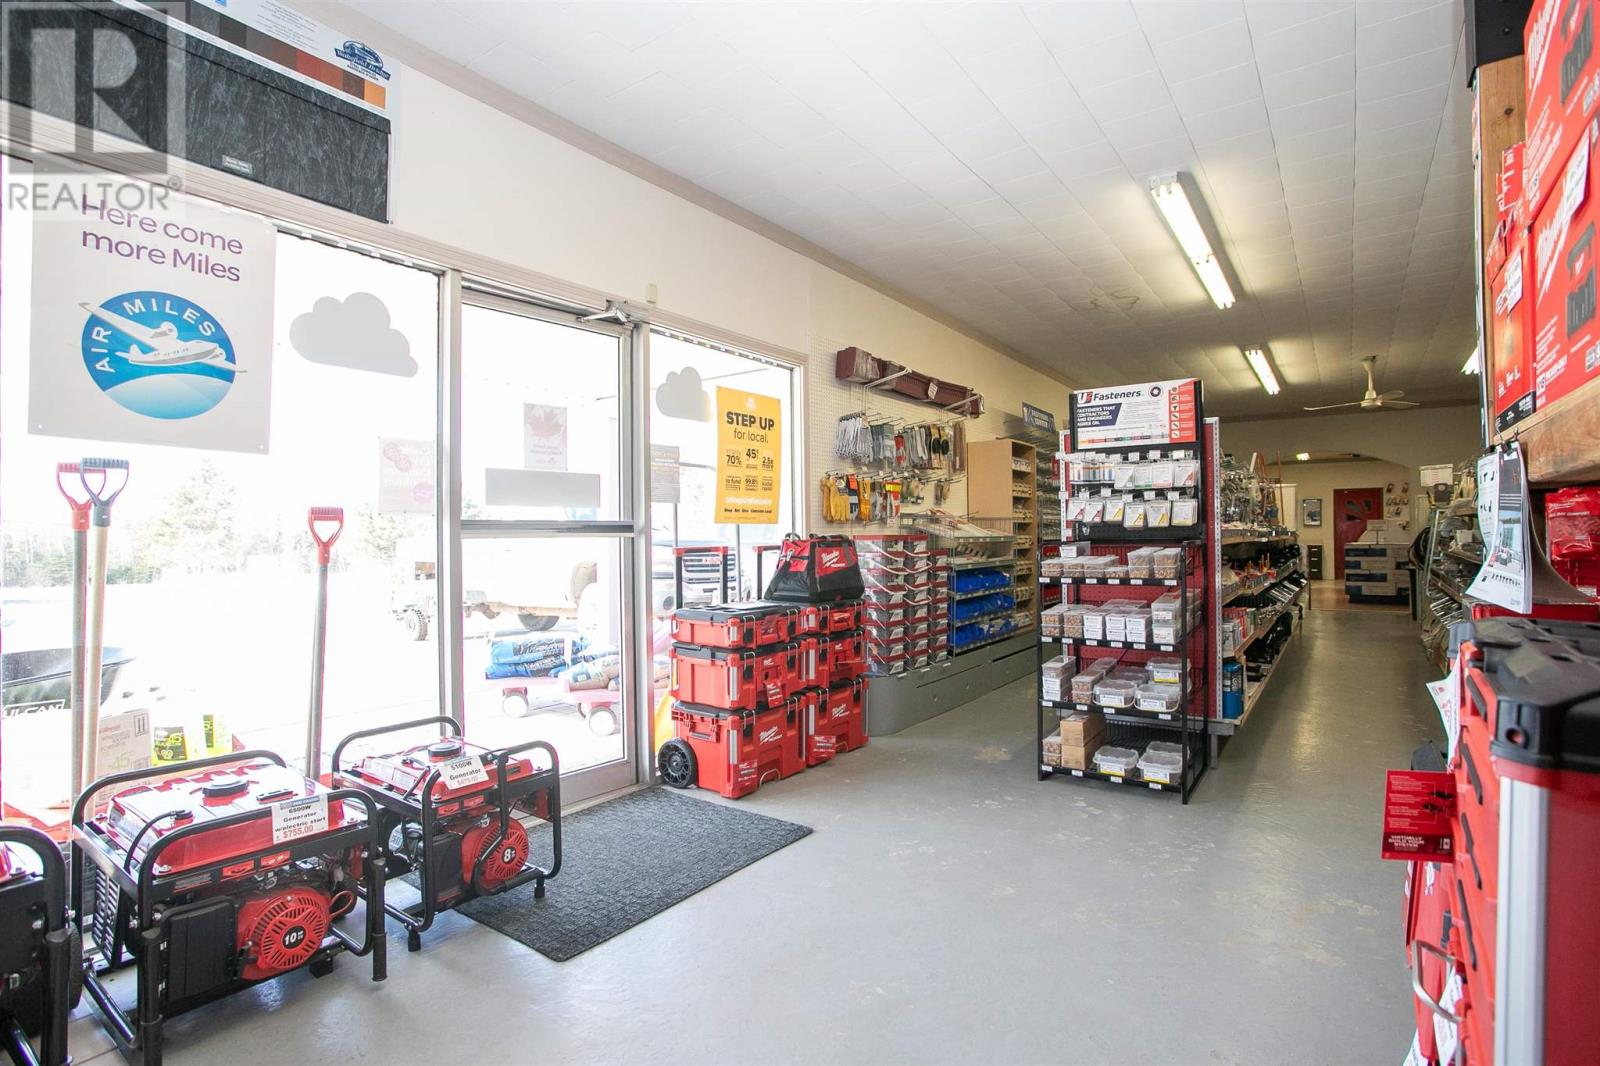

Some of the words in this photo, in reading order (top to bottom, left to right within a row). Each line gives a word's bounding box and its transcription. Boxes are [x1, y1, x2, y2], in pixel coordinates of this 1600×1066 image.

[82, 192, 157, 233] Here
[163, 222, 243, 255] come
[82, 230, 166, 265] more
[172, 248, 241, 282] Miles
[91, 325, 116, 374] AIR
[122, 298, 217, 337] MILES
[1093, 390, 1142, 401] Fasteners
[726, 411, 756, 427] STEP
[759, 416, 775, 431] UP
[734, 428, 746, 440] for
[748, 430, 769, 443] local.
[726, 454, 742, 465] 70%
[449, 768, 481, 781] Generator
[283, 812, 317, 822] Generator
[310, 816, 326, 825] start
[283, 825, 314, 838] $755.00
[504, 848, 511, 862] 8
[285, 932, 297, 945] 10
